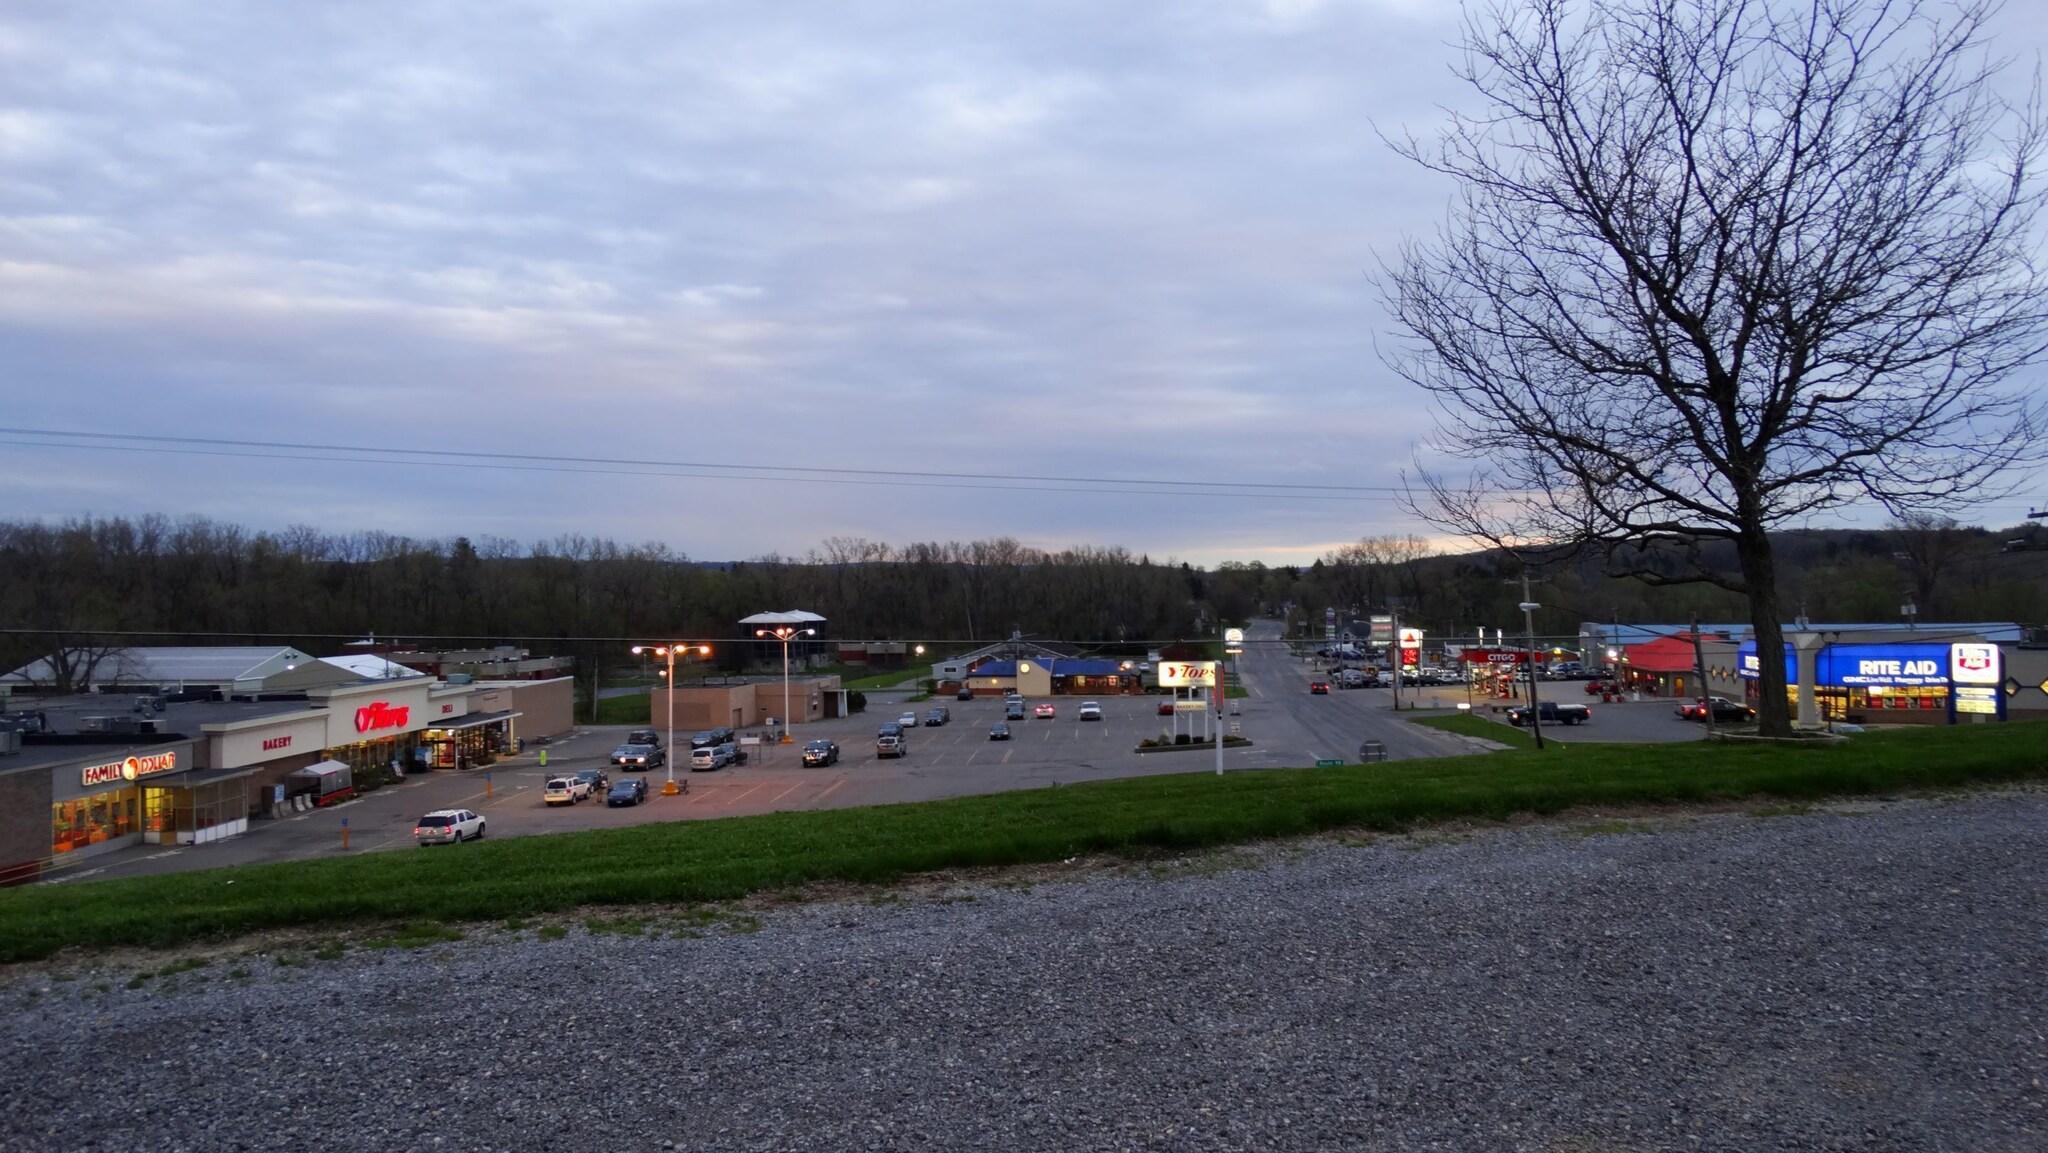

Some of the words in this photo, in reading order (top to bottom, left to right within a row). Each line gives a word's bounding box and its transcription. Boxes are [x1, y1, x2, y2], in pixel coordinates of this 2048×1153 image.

[1488, 653, 1515, 661] CITGO
[1860, 660, 1901, 675] RITE
[1904, 660, 1938, 675] AID
[442, 704, 453, 714] DELI
[263, 736, 292, 751] BAKERY
[83, 762, 123, 785] FAMILY
